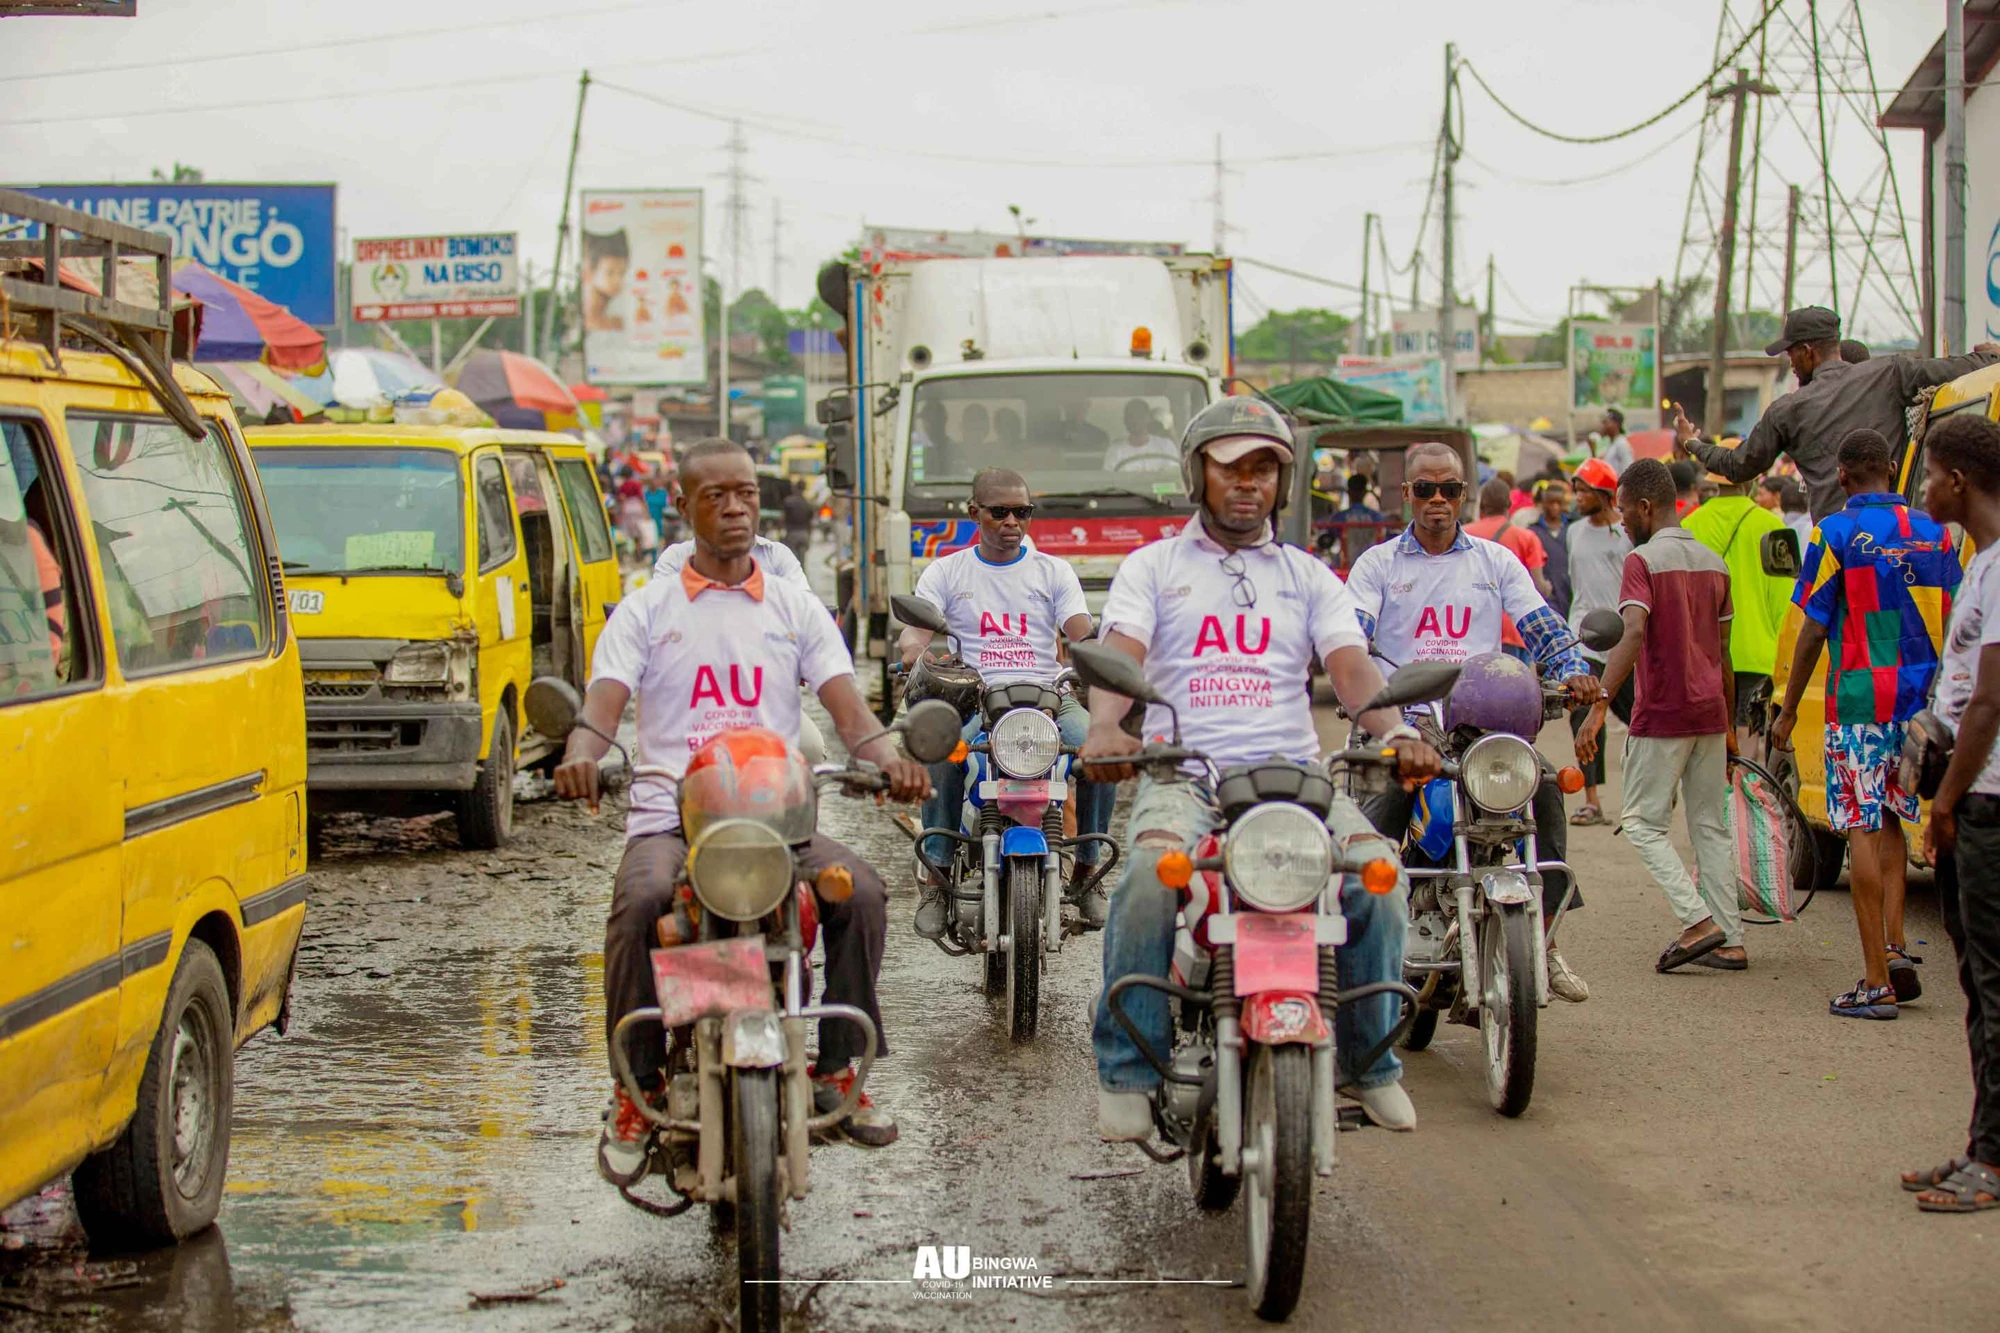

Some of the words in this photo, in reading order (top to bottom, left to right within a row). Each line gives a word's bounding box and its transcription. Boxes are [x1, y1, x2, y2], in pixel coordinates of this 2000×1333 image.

[159, 198, 261, 228] PATRIE
[424, 264, 449, 283] NA
[454, 262, 502, 283] BISO
[980, 611, 1028, 637] AU
[1414, 604, 1472, 639] AU
[1192, 613, 1271, 658] AU
[1425, 639, 1459, 648] COVID-19
[980, 650, 1036, 662] BINGWA
[1416, 647, 1467, 657] VACCINATION
[690, 664, 763, 709] AU
[1189, 676, 1272, 694] BINGWA
[1190, 694, 1273, 710] INITIATIVE
